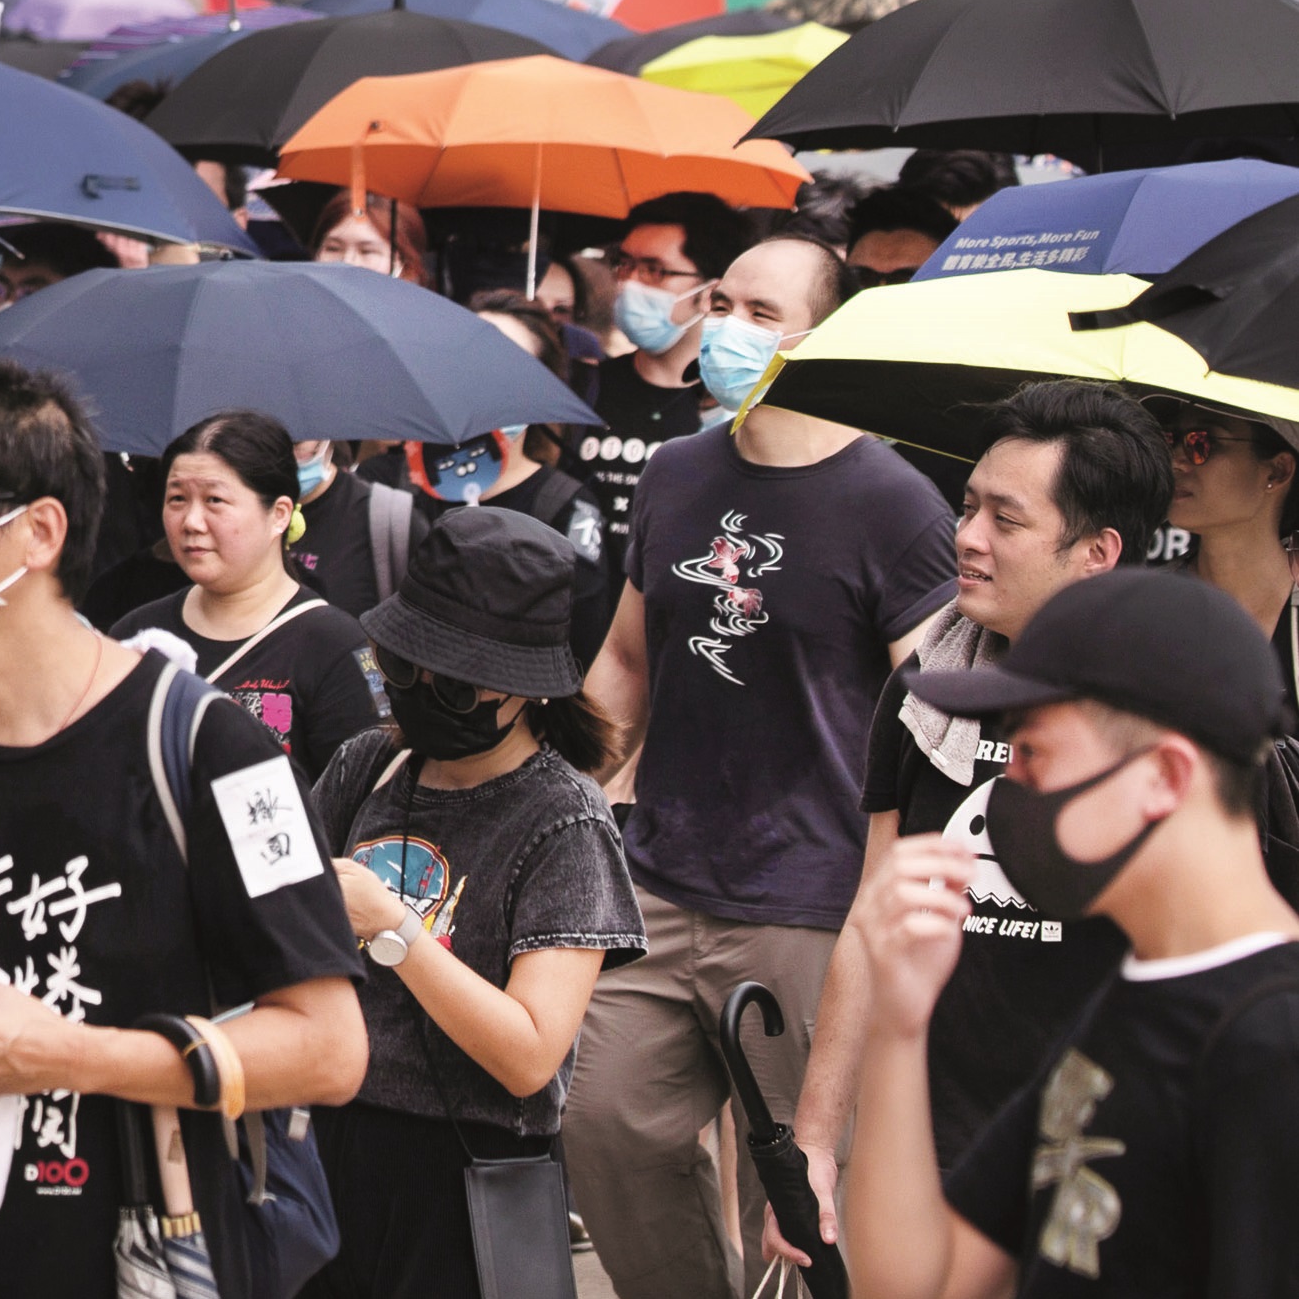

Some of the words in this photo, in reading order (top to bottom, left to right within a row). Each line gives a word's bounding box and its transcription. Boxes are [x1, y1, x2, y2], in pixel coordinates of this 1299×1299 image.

[955, 237, 988, 249] More
[1073, 229, 1100, 241] Fun
[962, 914, 998, 935] NICE
[999, 918, 1040, 940] LIFE!
[24, 1157, 90, 1188] D100
